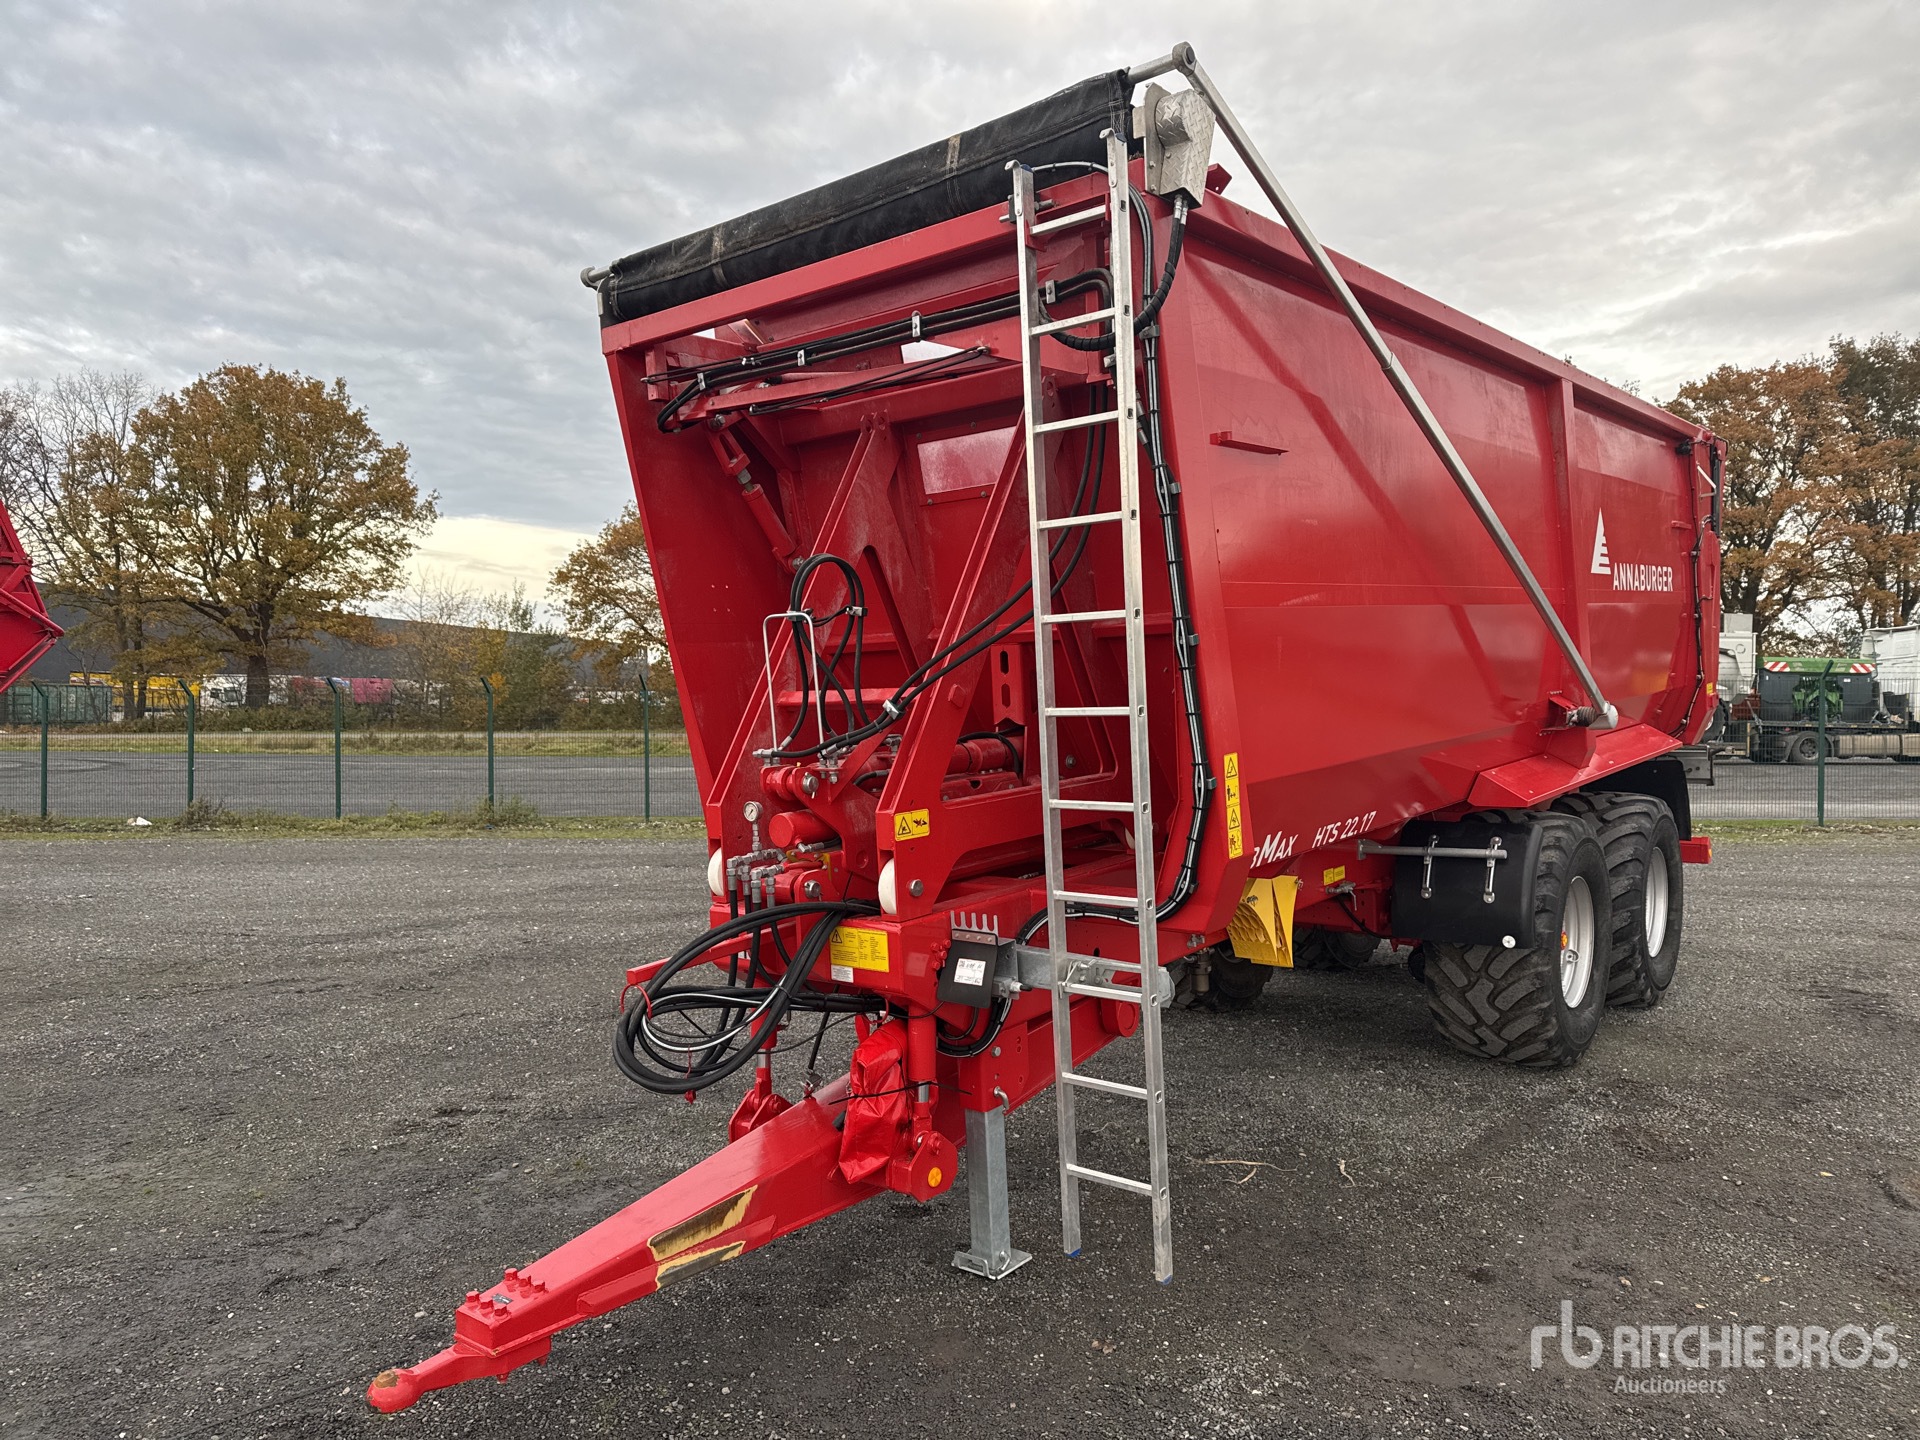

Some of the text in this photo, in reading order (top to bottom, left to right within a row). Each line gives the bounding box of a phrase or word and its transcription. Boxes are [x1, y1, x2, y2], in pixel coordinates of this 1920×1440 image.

[1613, 562, 1673, 592] ANNABURGER
[1311, 821, 1341, 849] HTS
[1339, 810, 1377, 840] 22.17
